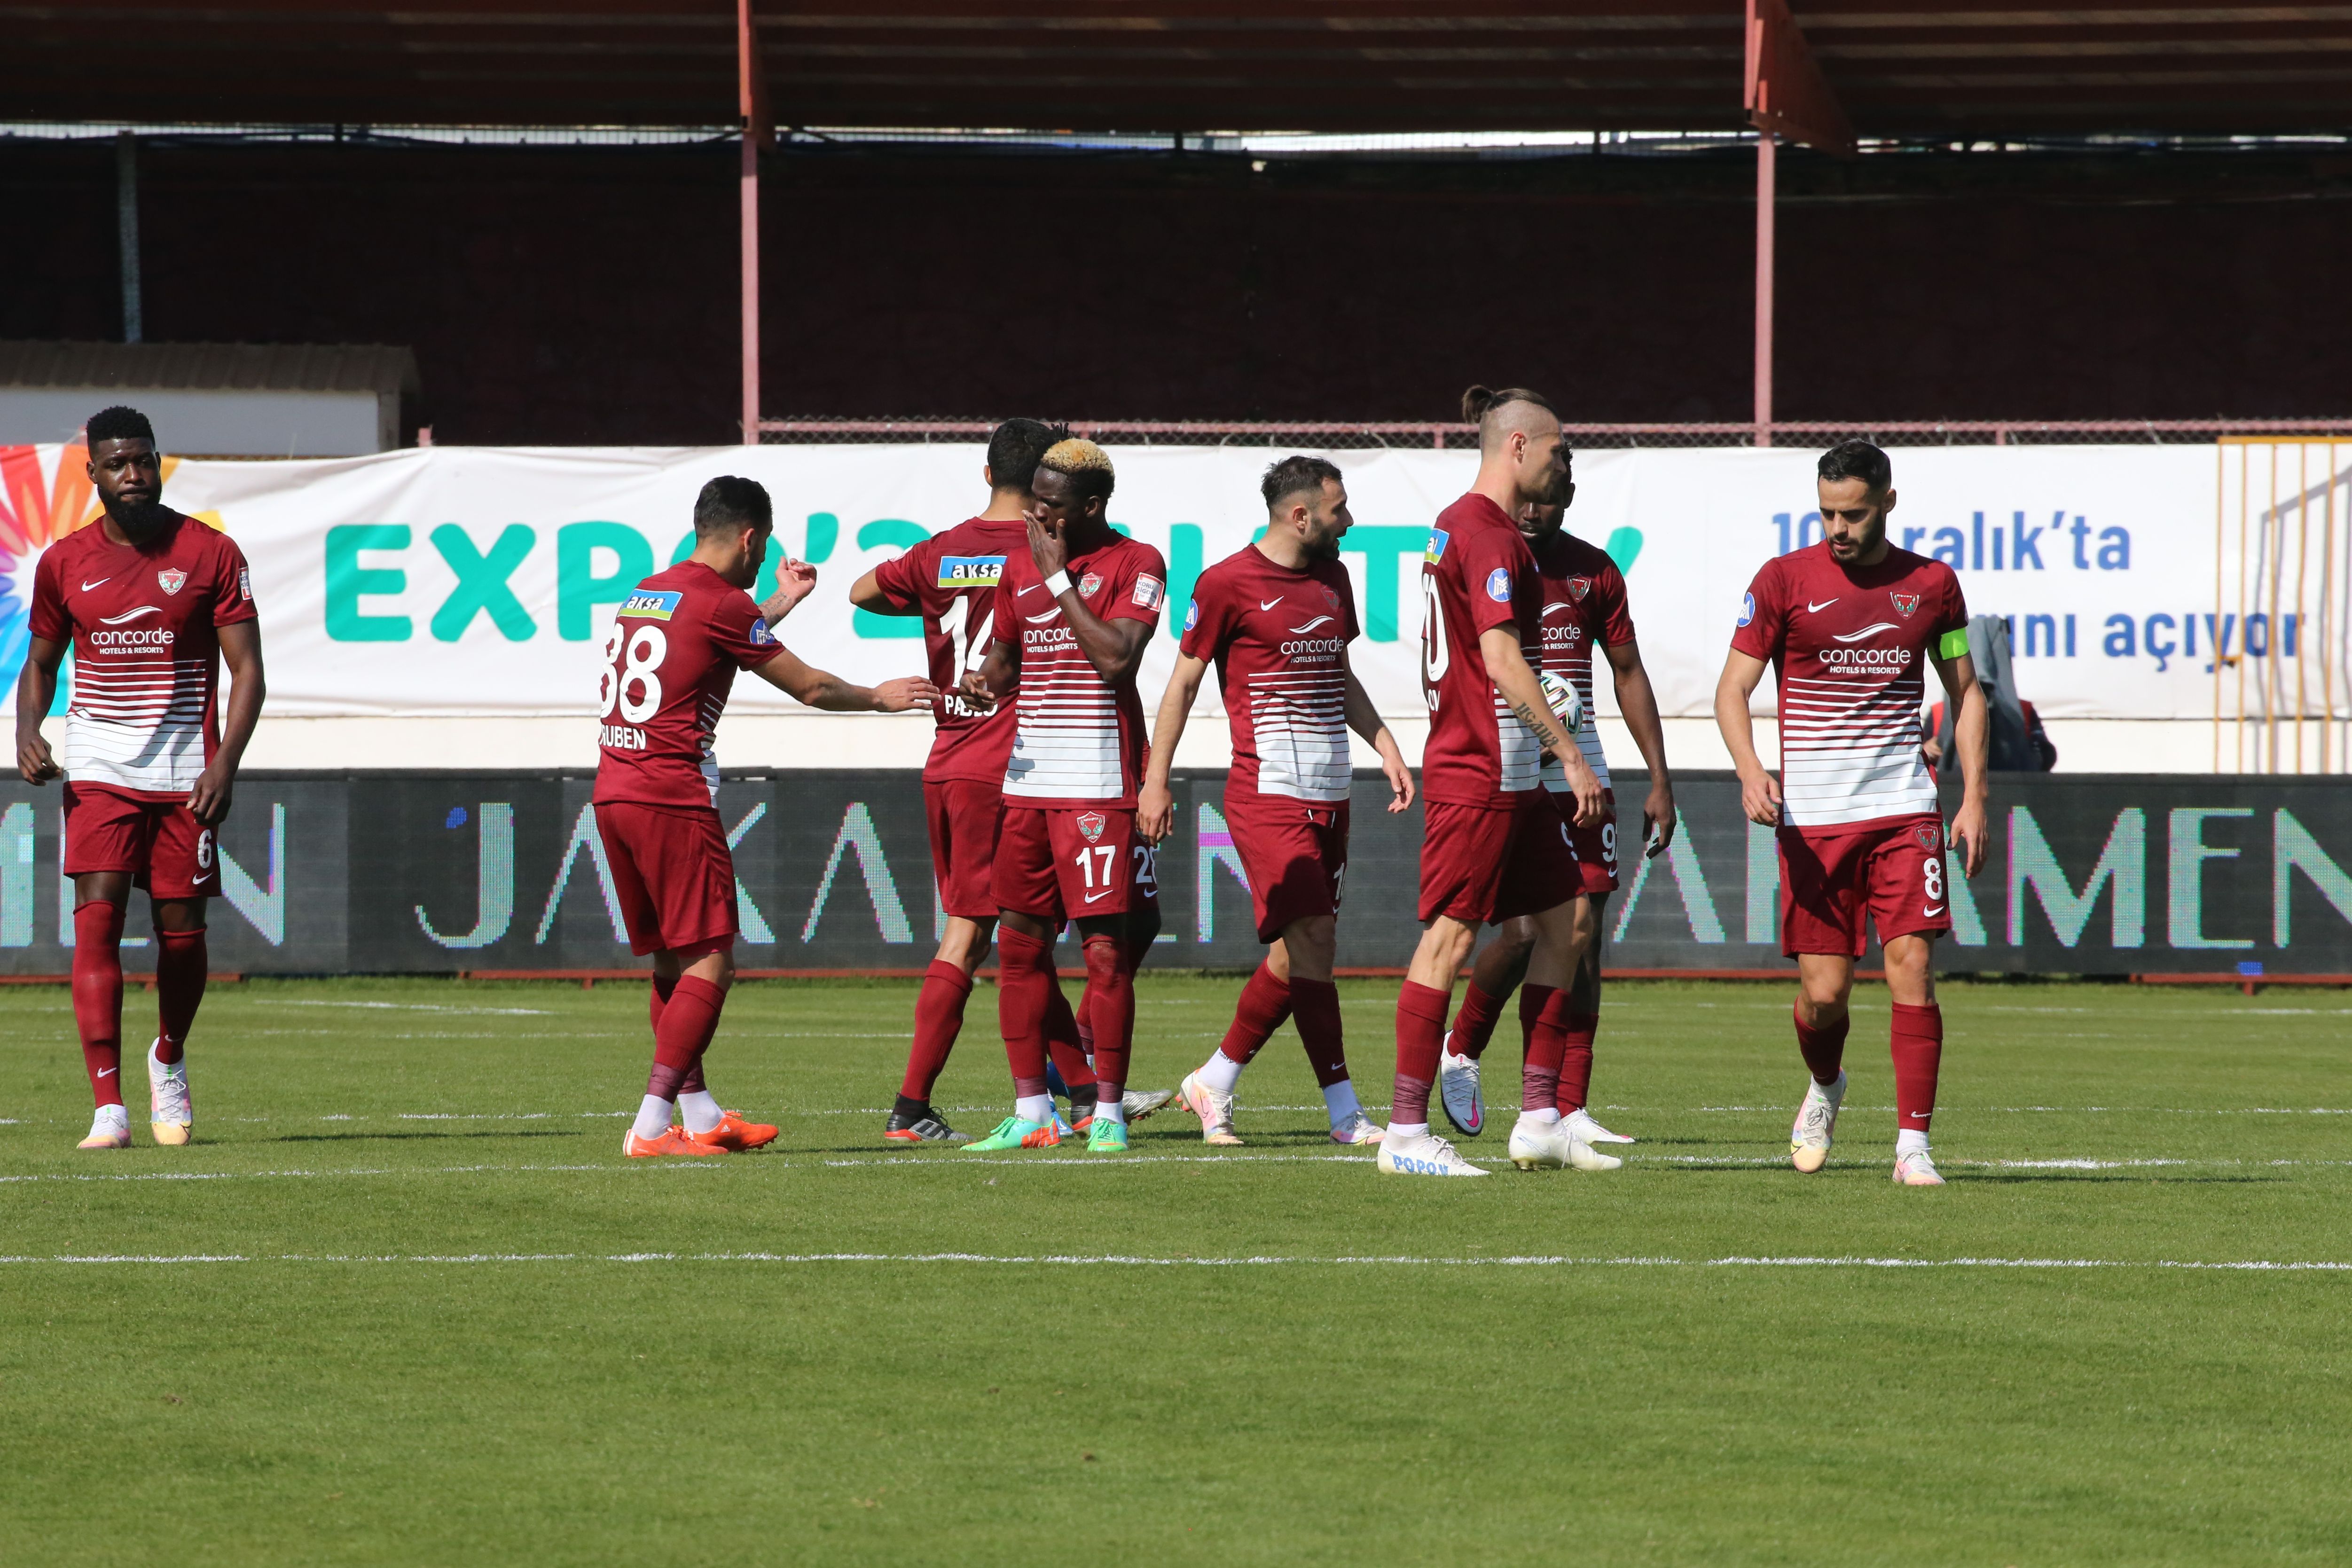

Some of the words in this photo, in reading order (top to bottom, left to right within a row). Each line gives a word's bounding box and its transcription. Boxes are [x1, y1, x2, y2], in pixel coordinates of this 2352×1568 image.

[1902, 511, 2130, 570] ralık'ta
[952, 564, 1003, 579] aksa
[1137, 580, 1154, 589] KORU
[627, 596, 664, 610] aksa
[91, 627, 174, 645] concorde
[1542, 623, 1581, 641] corde
[1280, 635, 1344, 655] concorde
[2102, 612, 2306, 674] açıyor
[1819, 645, 1911, 664] concorde
[599, 724, 647, 750] RUBEN
[197, 829, 212, 869] 6
[1075, 845, 1116, 888] 17
[1923, 857, 1942, 901] 8
[1393, 1154, 1449, 1176] POPOV
